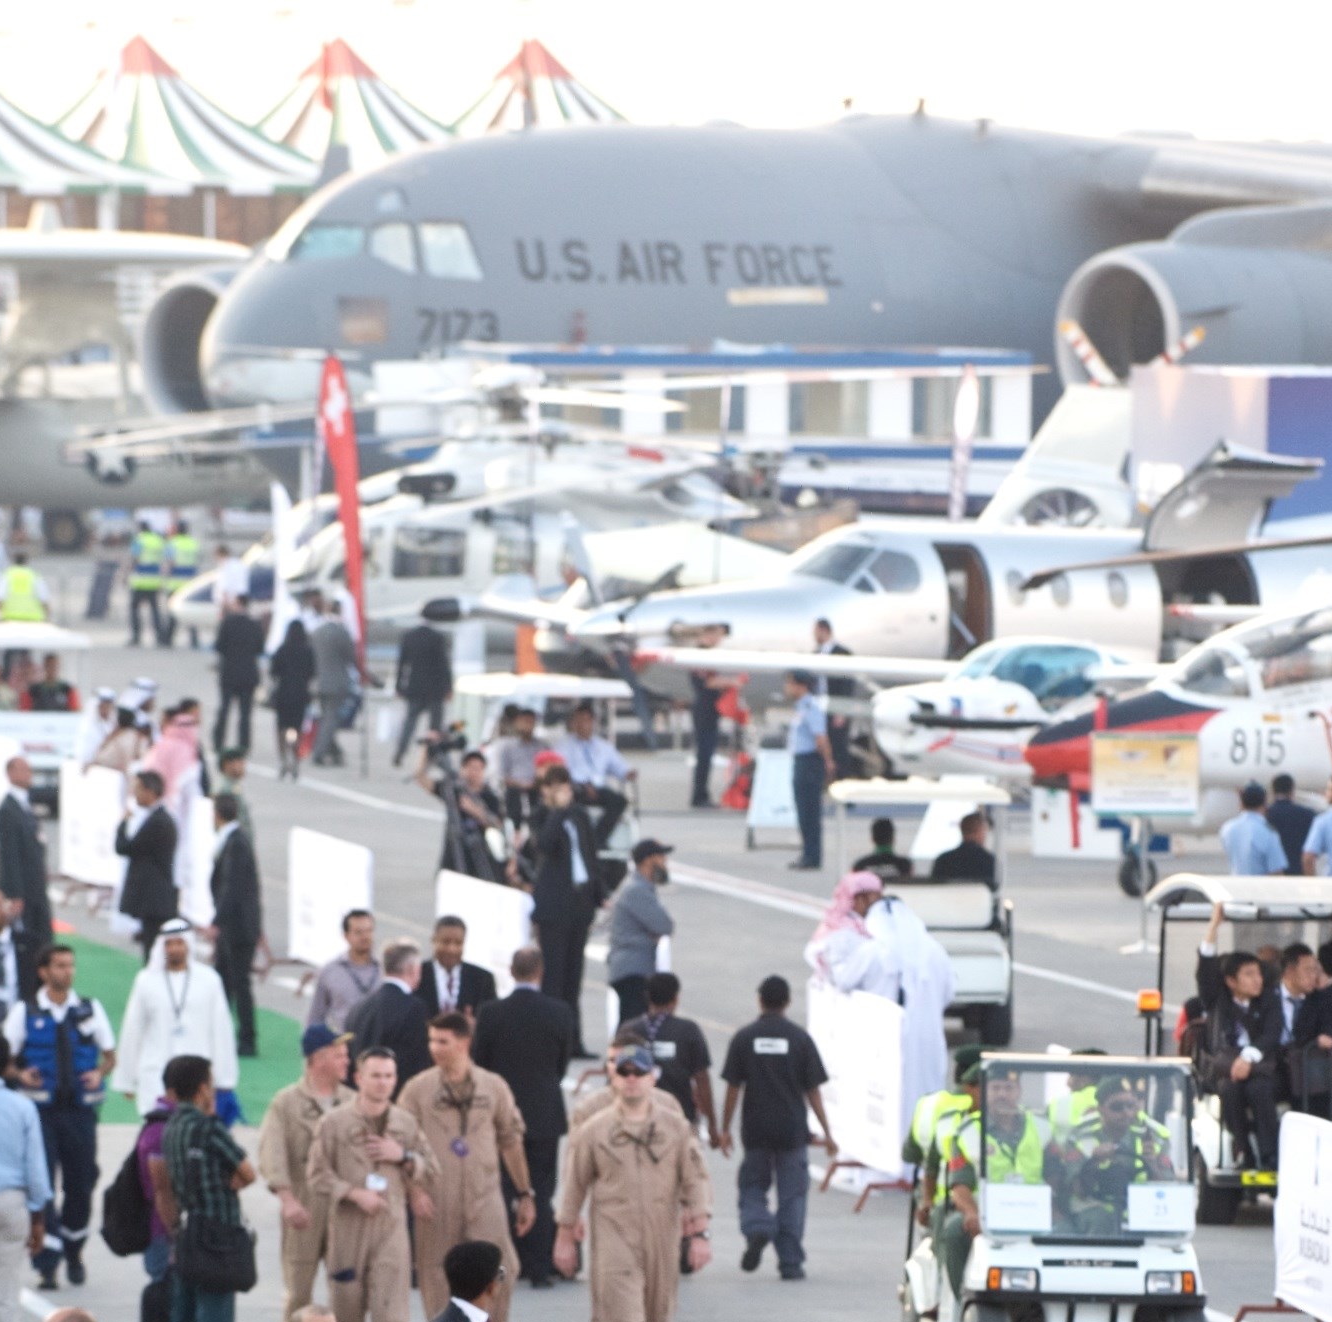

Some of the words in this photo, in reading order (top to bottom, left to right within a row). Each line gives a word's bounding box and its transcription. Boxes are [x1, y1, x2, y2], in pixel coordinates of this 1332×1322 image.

[515, 238, 606, 284] U.S.
[617, 241, 686, 284] AIR
[702, 242, 843, 287] FORCE
[416, 309, 499, 343] 7173
[1229, 728, 1287, 766] 815
